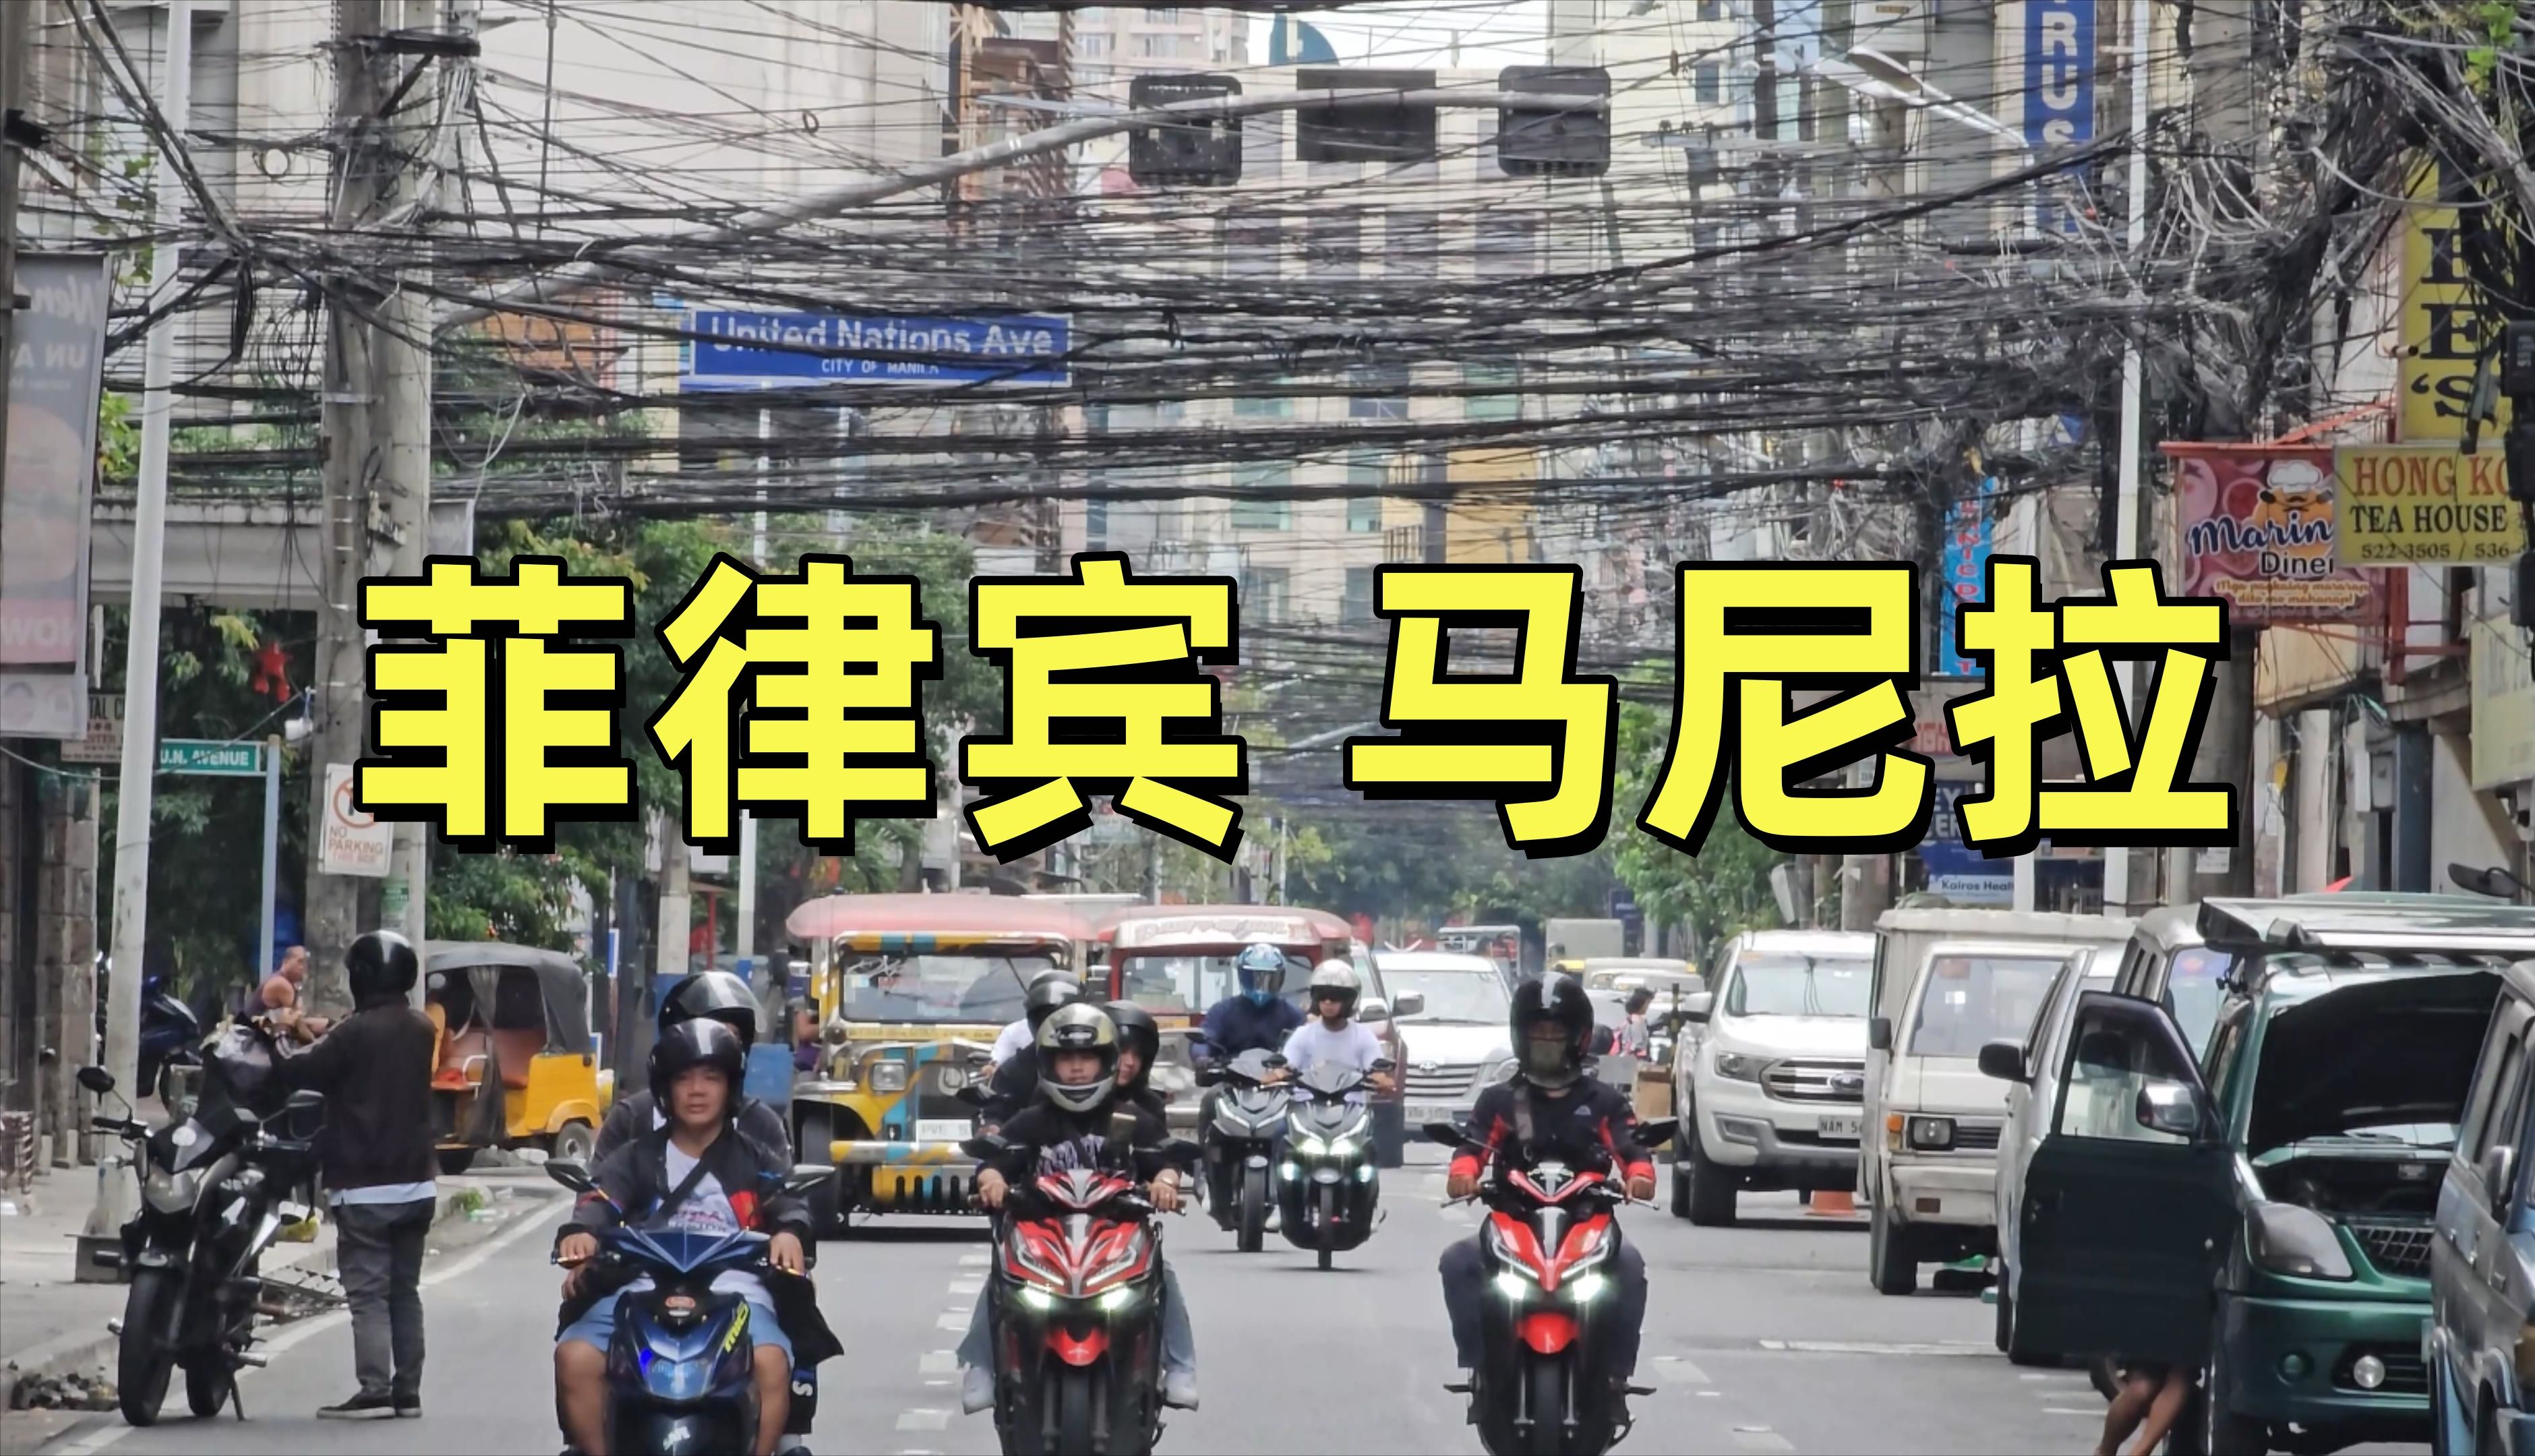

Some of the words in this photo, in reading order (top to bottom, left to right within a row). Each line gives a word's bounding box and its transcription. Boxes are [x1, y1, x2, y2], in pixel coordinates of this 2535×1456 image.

[712, 316, 826, 352] United
[837, 320, 971, 353] Nations
[982, 325, 1053, 355] Ave
[822, 359, 853, 373] CITY
[2353, 456, 2454, 497] HONG
[2350, 504, 2404, 533] TEA
[2413, 504, 2508, 533] HOUSE
[160, 748, 187, 764] U.N.
[192, 749, 249, 766] AVENUE
[330, 826, 347, 838] NO
[328, 839, 384, 855] PARKING
[1942, 879, 1980, 890] Kairos
[1821, 1121, 1843, 1133] NAM
